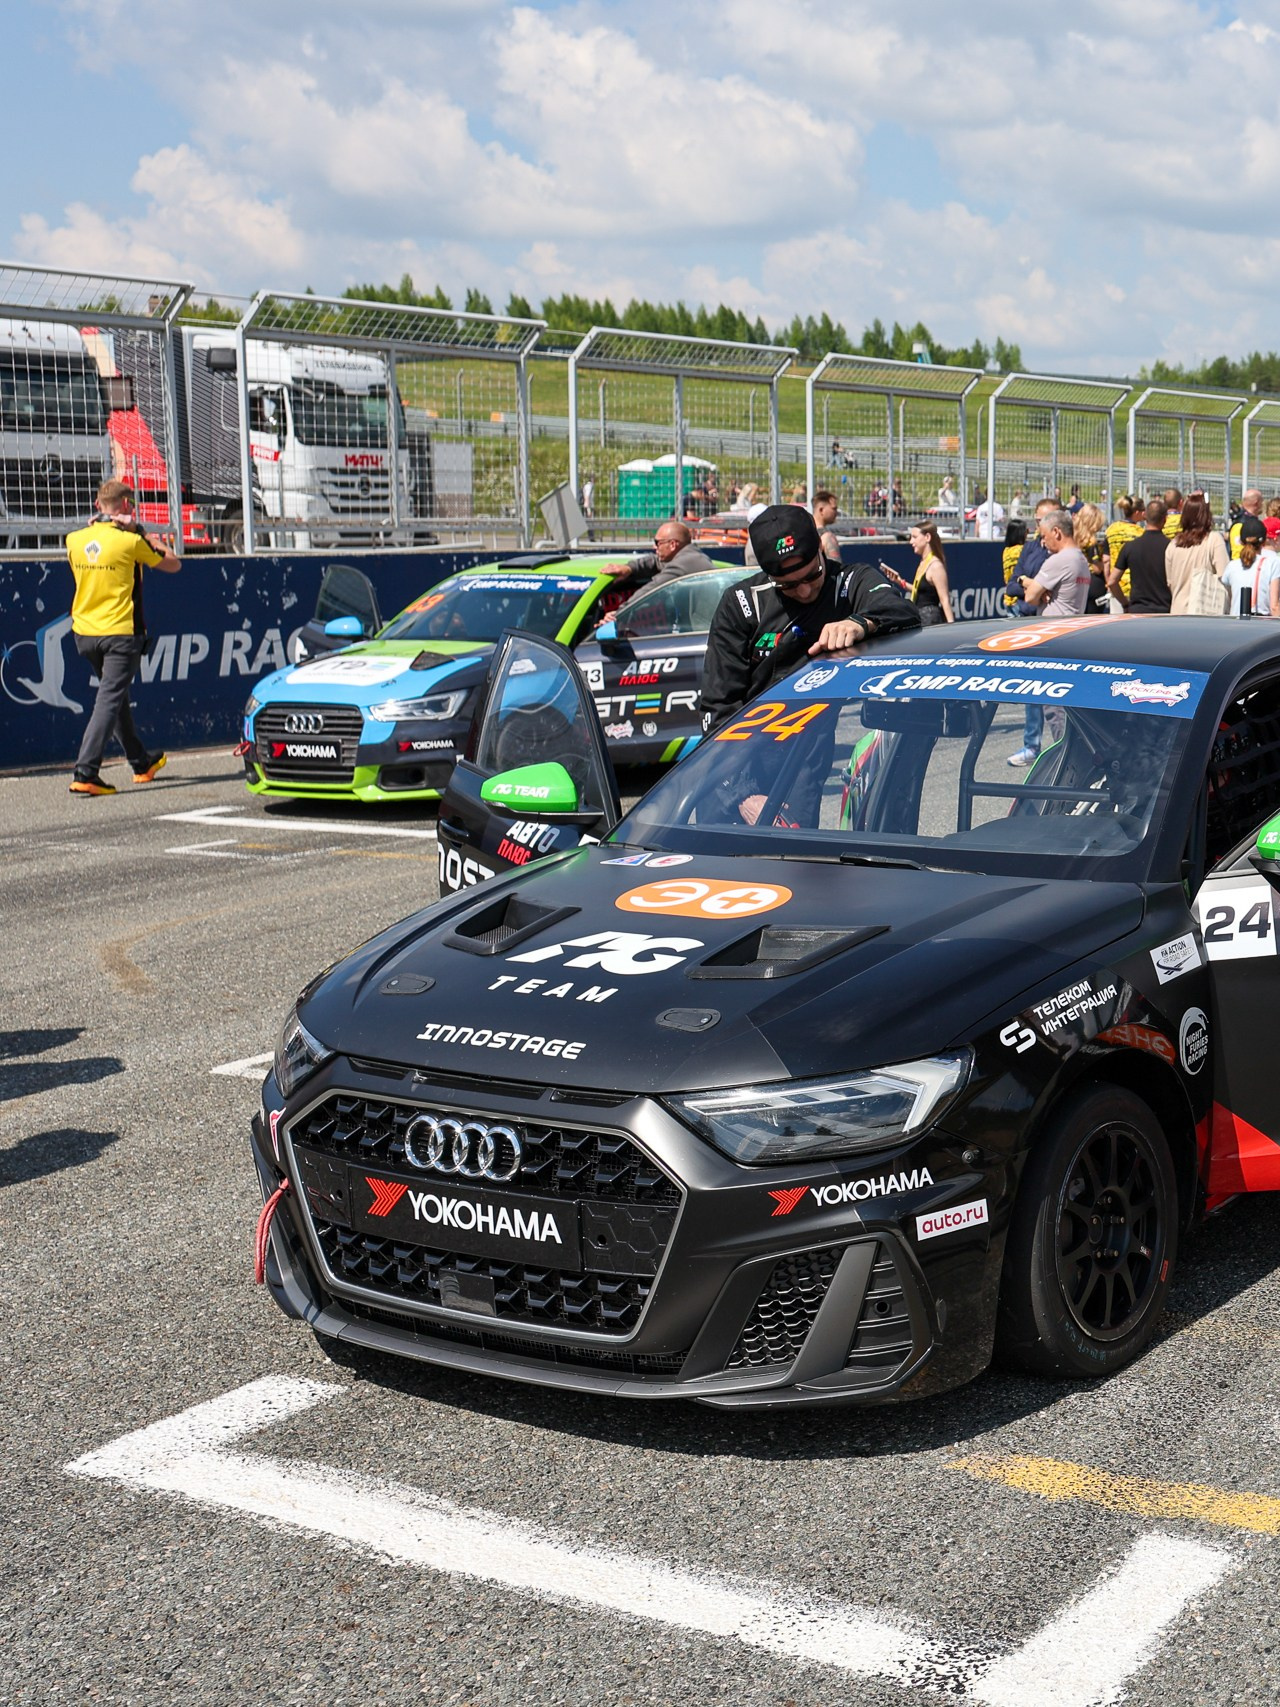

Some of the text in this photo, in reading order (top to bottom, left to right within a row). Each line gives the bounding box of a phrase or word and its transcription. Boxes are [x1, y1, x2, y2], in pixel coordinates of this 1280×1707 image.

[622, 657, 679, 676] АВТО
[845, 657, 1136, 676] Российская серия кольцевых гонок
[619, 673, 660, 686] ПЛЮС
[895, 675, 1075, 698] SMP RACING
[714, 702, 830, 741] 24
[286, 744, 337, 759] YOKOHAMA
[411, 740, 454, 751] YOKOHAMA
[514, 785, 550, 798] TEAM
[506, 820, 560, 853] АВТО
[497, 838, 532, 866] ПЛЮС
[1204, 902, 1271, 943] 24
[1168, 940, 1187, 955] ACTION
[488, 976, 619, 1003] TEAM
[1033, 980, 1092, 1019] ТЕЛЕКОМ
[1041, 984, 1117, 1036] ИНТЕГРАЦИЯ
[416, 1022, 587, 1060] INNOSTAGE
[1186, 1028, 1203, 1046] NIGHT
[1189, 1035, 1208, 1055] FURIES
[1188, 1045, 1208, 1065] RACING
[810, 1167, 934, 1207] YOKOHAMA
[407, 1189, 563, 1244] YOKOHAMA
[922, 1206, 984, 1234] auto.ru
